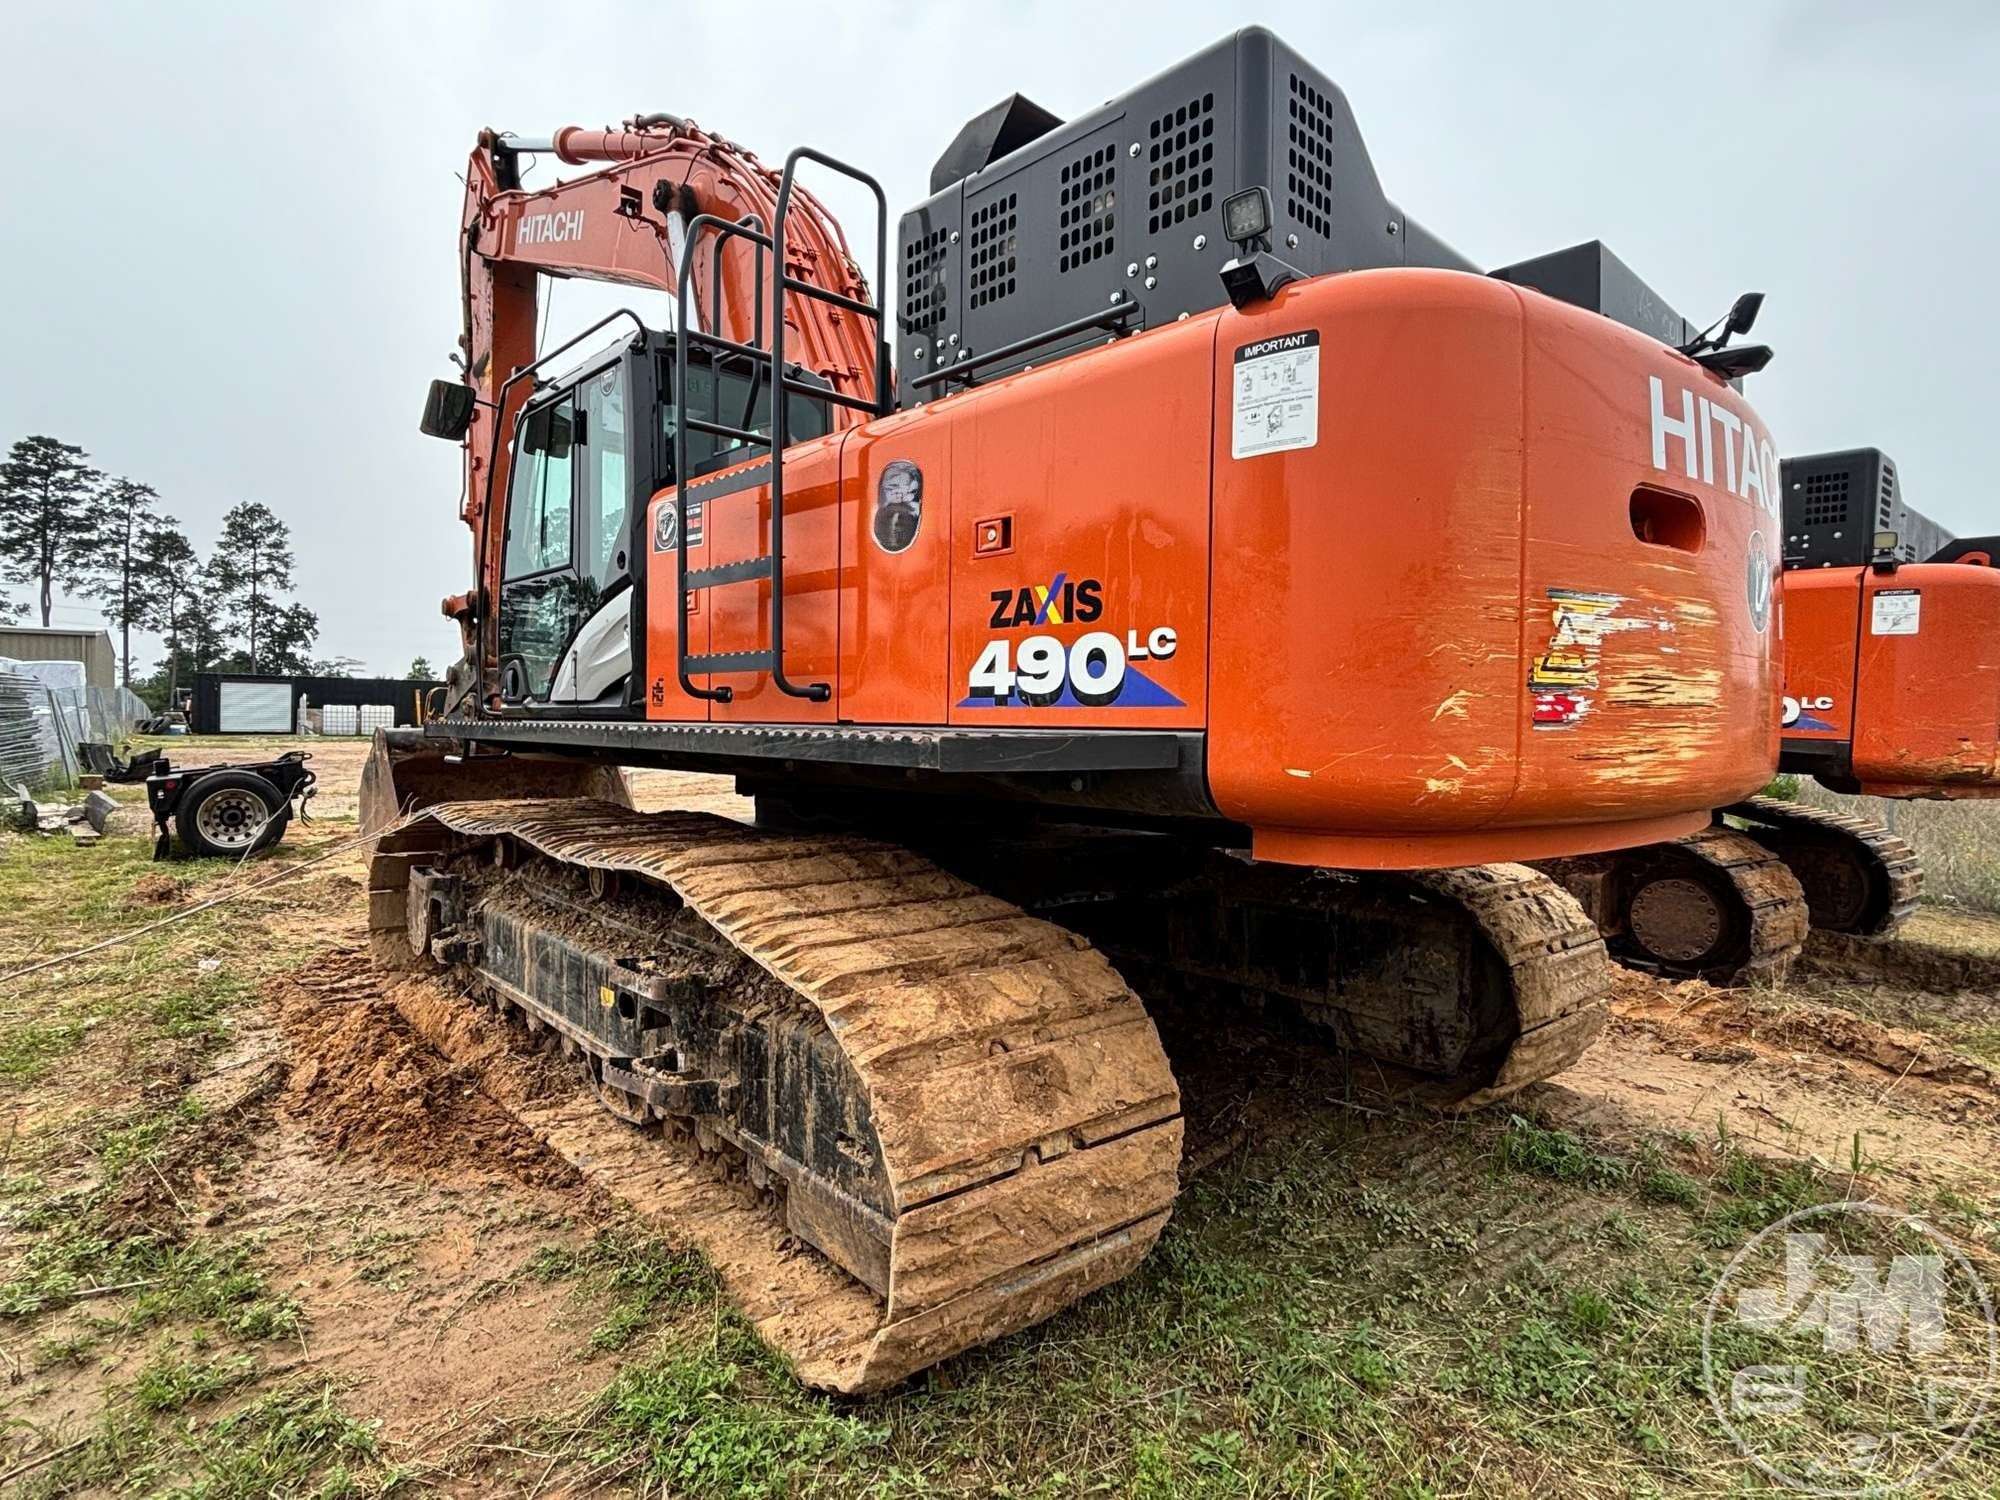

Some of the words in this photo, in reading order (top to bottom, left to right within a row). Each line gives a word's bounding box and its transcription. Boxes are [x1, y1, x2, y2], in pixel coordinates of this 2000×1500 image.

[518, 209, 585, 244] HITACHI
[1244, 333, 1308, 359] IMPORTANT
[989, 572, 1105, 629] ZAXIS
